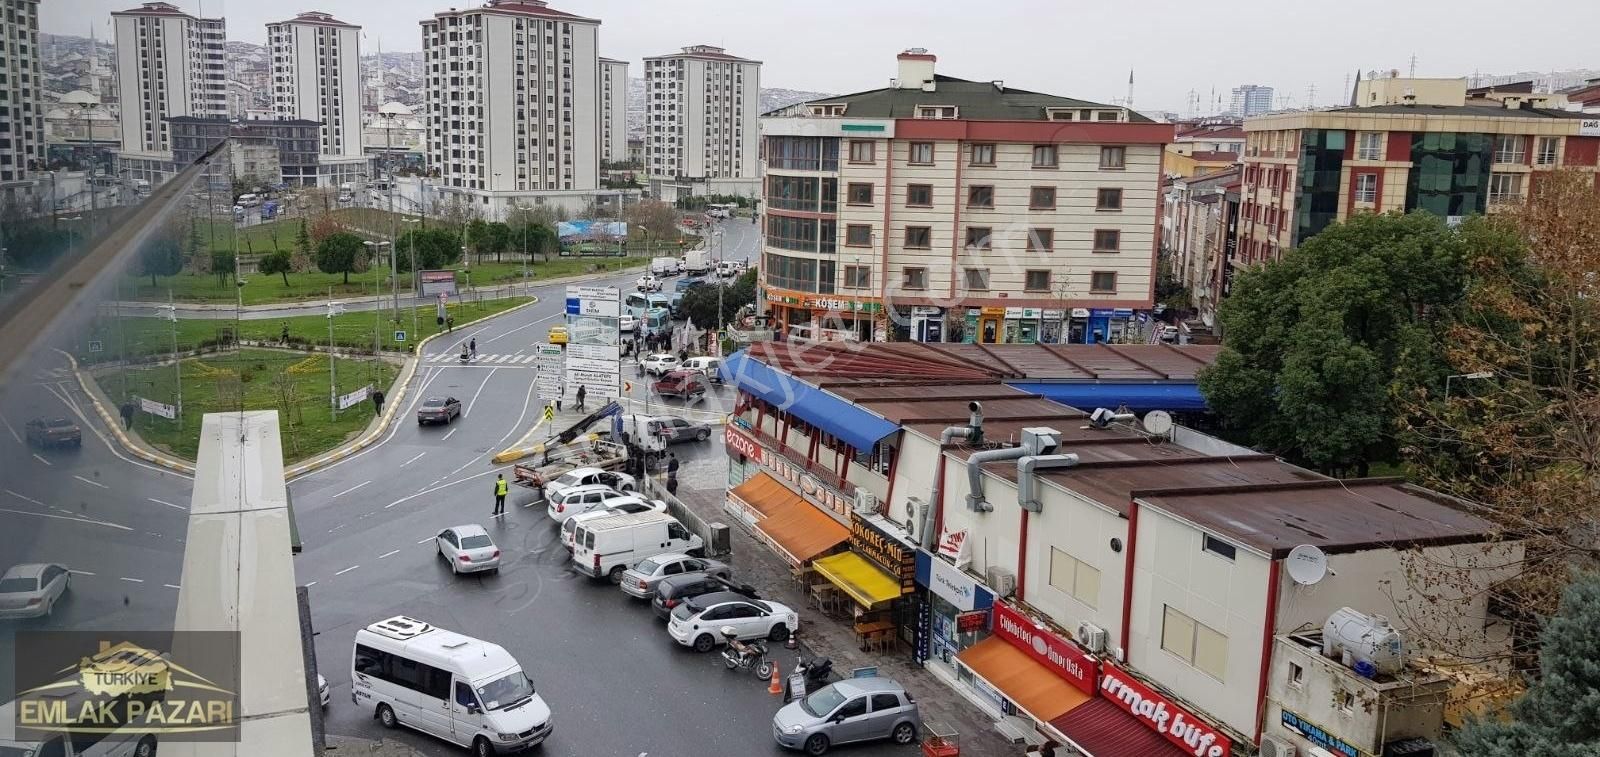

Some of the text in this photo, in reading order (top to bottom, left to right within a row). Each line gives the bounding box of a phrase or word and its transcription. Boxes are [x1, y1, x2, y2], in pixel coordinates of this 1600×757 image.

[815, 297, 845, 311] KÖŞEM
[1170, 712, 1224, 757] büfe
[1282, 711, 1297, 726] OTO
[1297, 718, 1327, 743] YIKAMA
[1336, 740, 1357, 757] PARK
